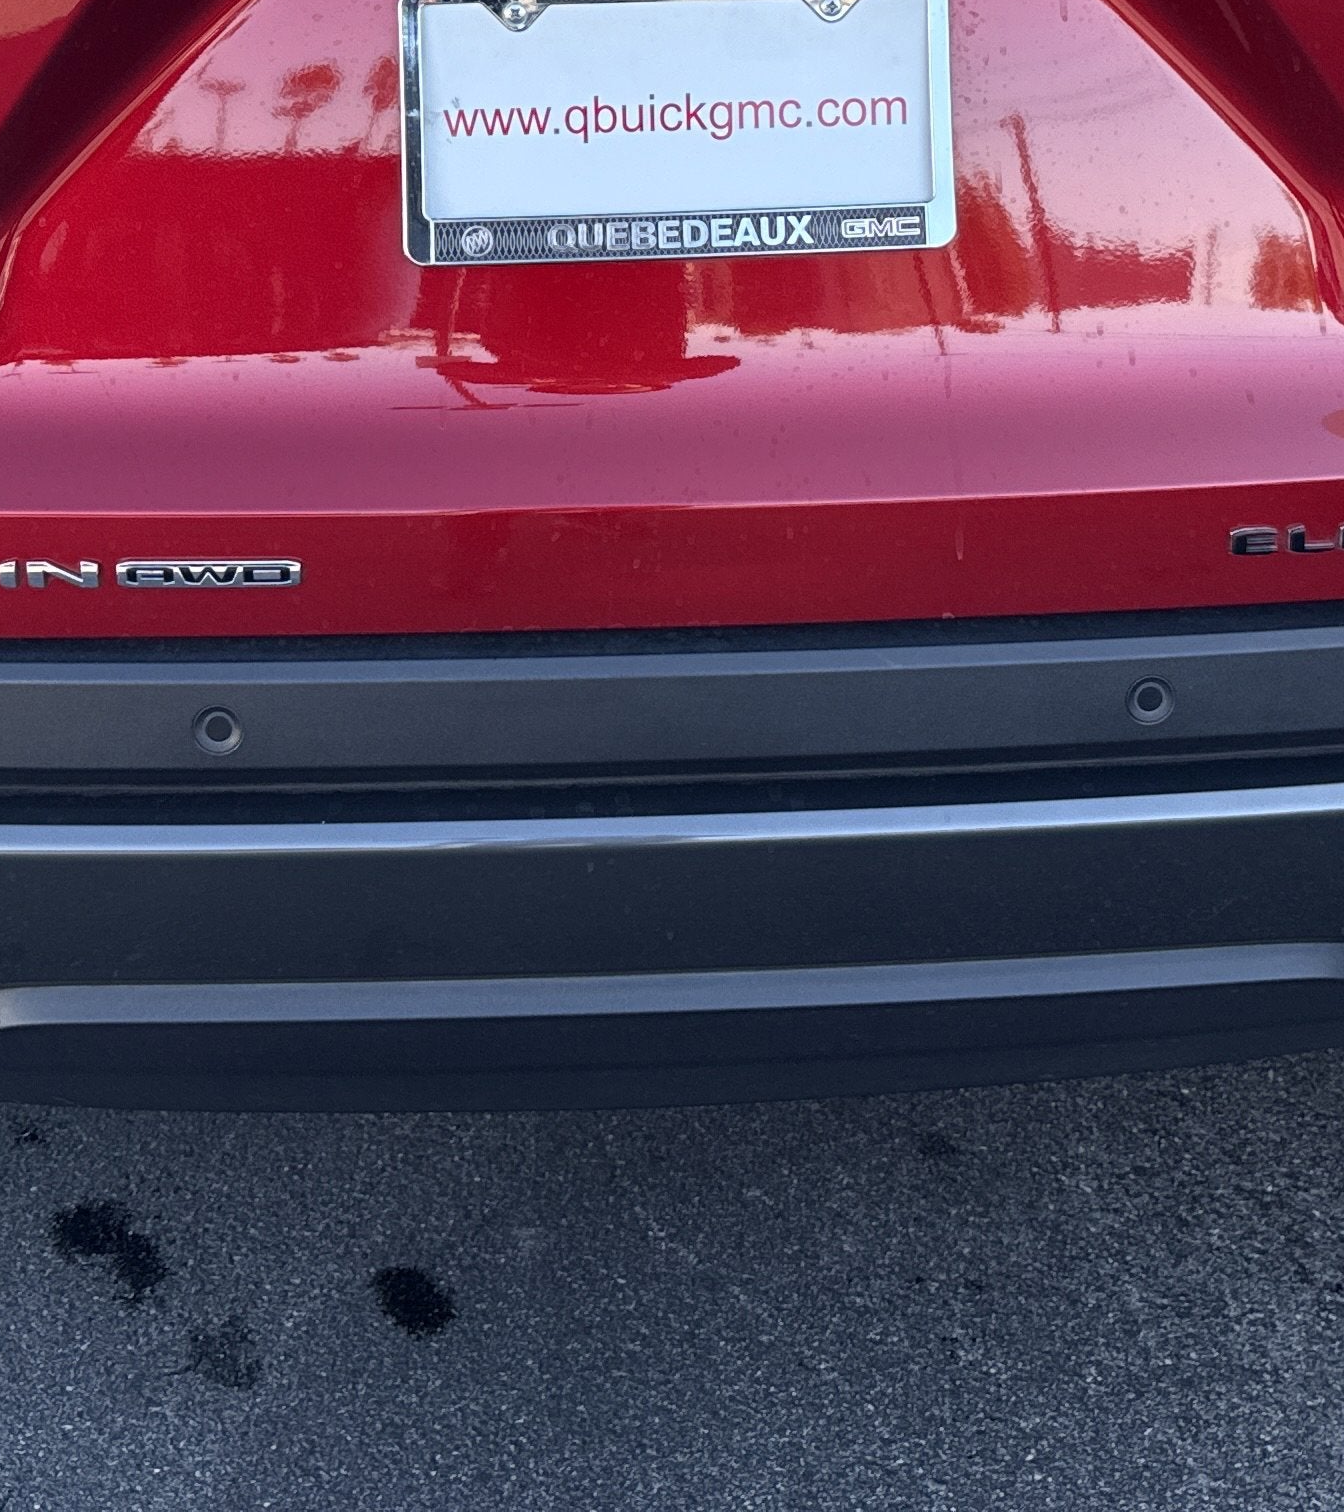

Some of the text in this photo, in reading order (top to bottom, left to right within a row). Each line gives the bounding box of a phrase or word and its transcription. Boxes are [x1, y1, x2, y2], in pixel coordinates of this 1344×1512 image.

[442, 92, 909, 144] www.qbuickgmc.com
[547, 214, 922, 253] QUEBEDEAUX GMC
[121, 561, 298, 587] AWD
